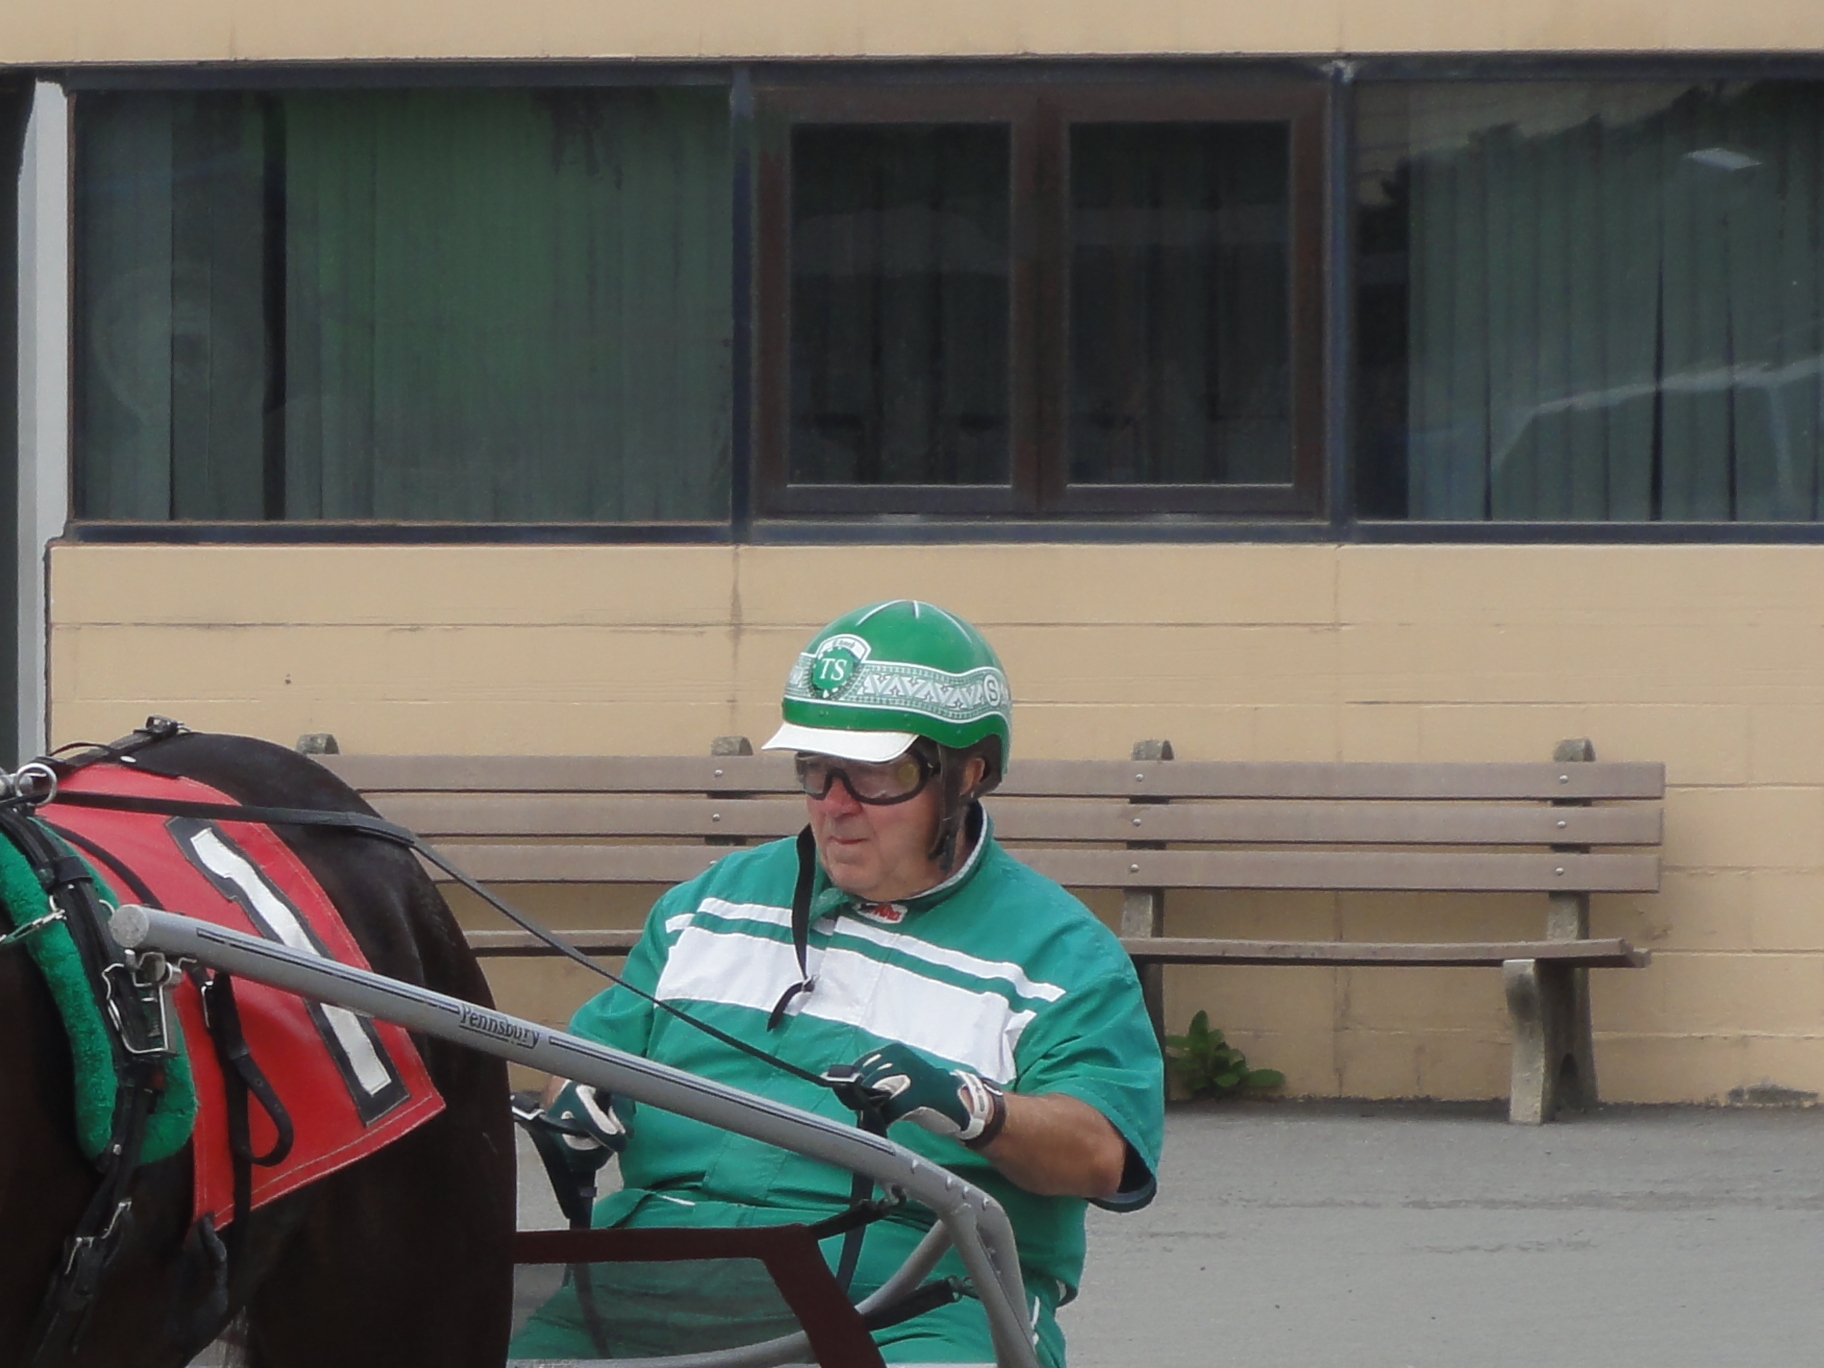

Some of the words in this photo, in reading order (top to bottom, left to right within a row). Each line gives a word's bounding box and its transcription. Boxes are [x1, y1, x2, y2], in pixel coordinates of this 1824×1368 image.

[819, 658, 848, 681] TS
[189, 827, 393, 1096] 1
[460, 1003, 541, 1049] Pennsbury
